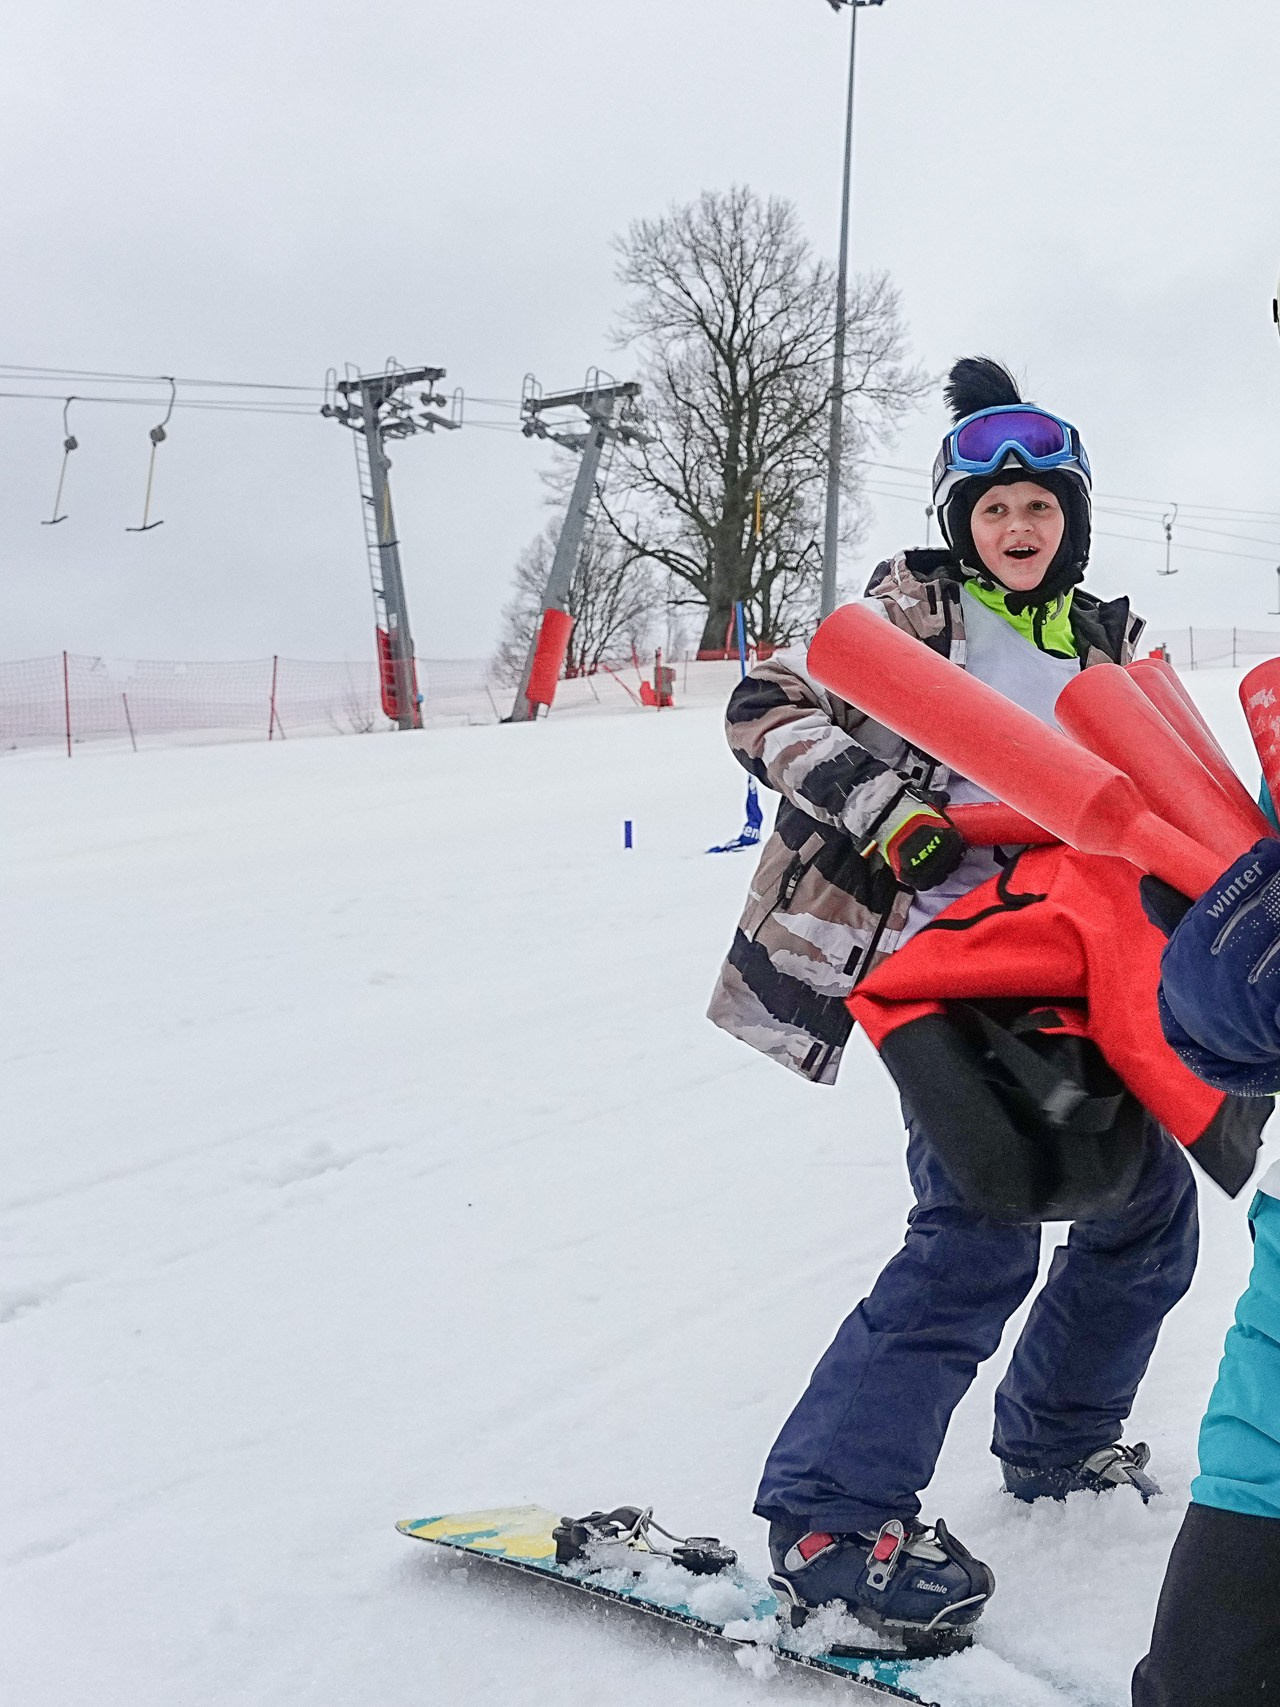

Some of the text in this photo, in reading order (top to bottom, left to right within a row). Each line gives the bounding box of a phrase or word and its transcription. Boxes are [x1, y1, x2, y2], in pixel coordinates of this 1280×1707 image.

[911, 835, 941, 866] LEKI
[1206, 861, 1263, 919] winter
[916, 1579, 948, 1594] Raichle
